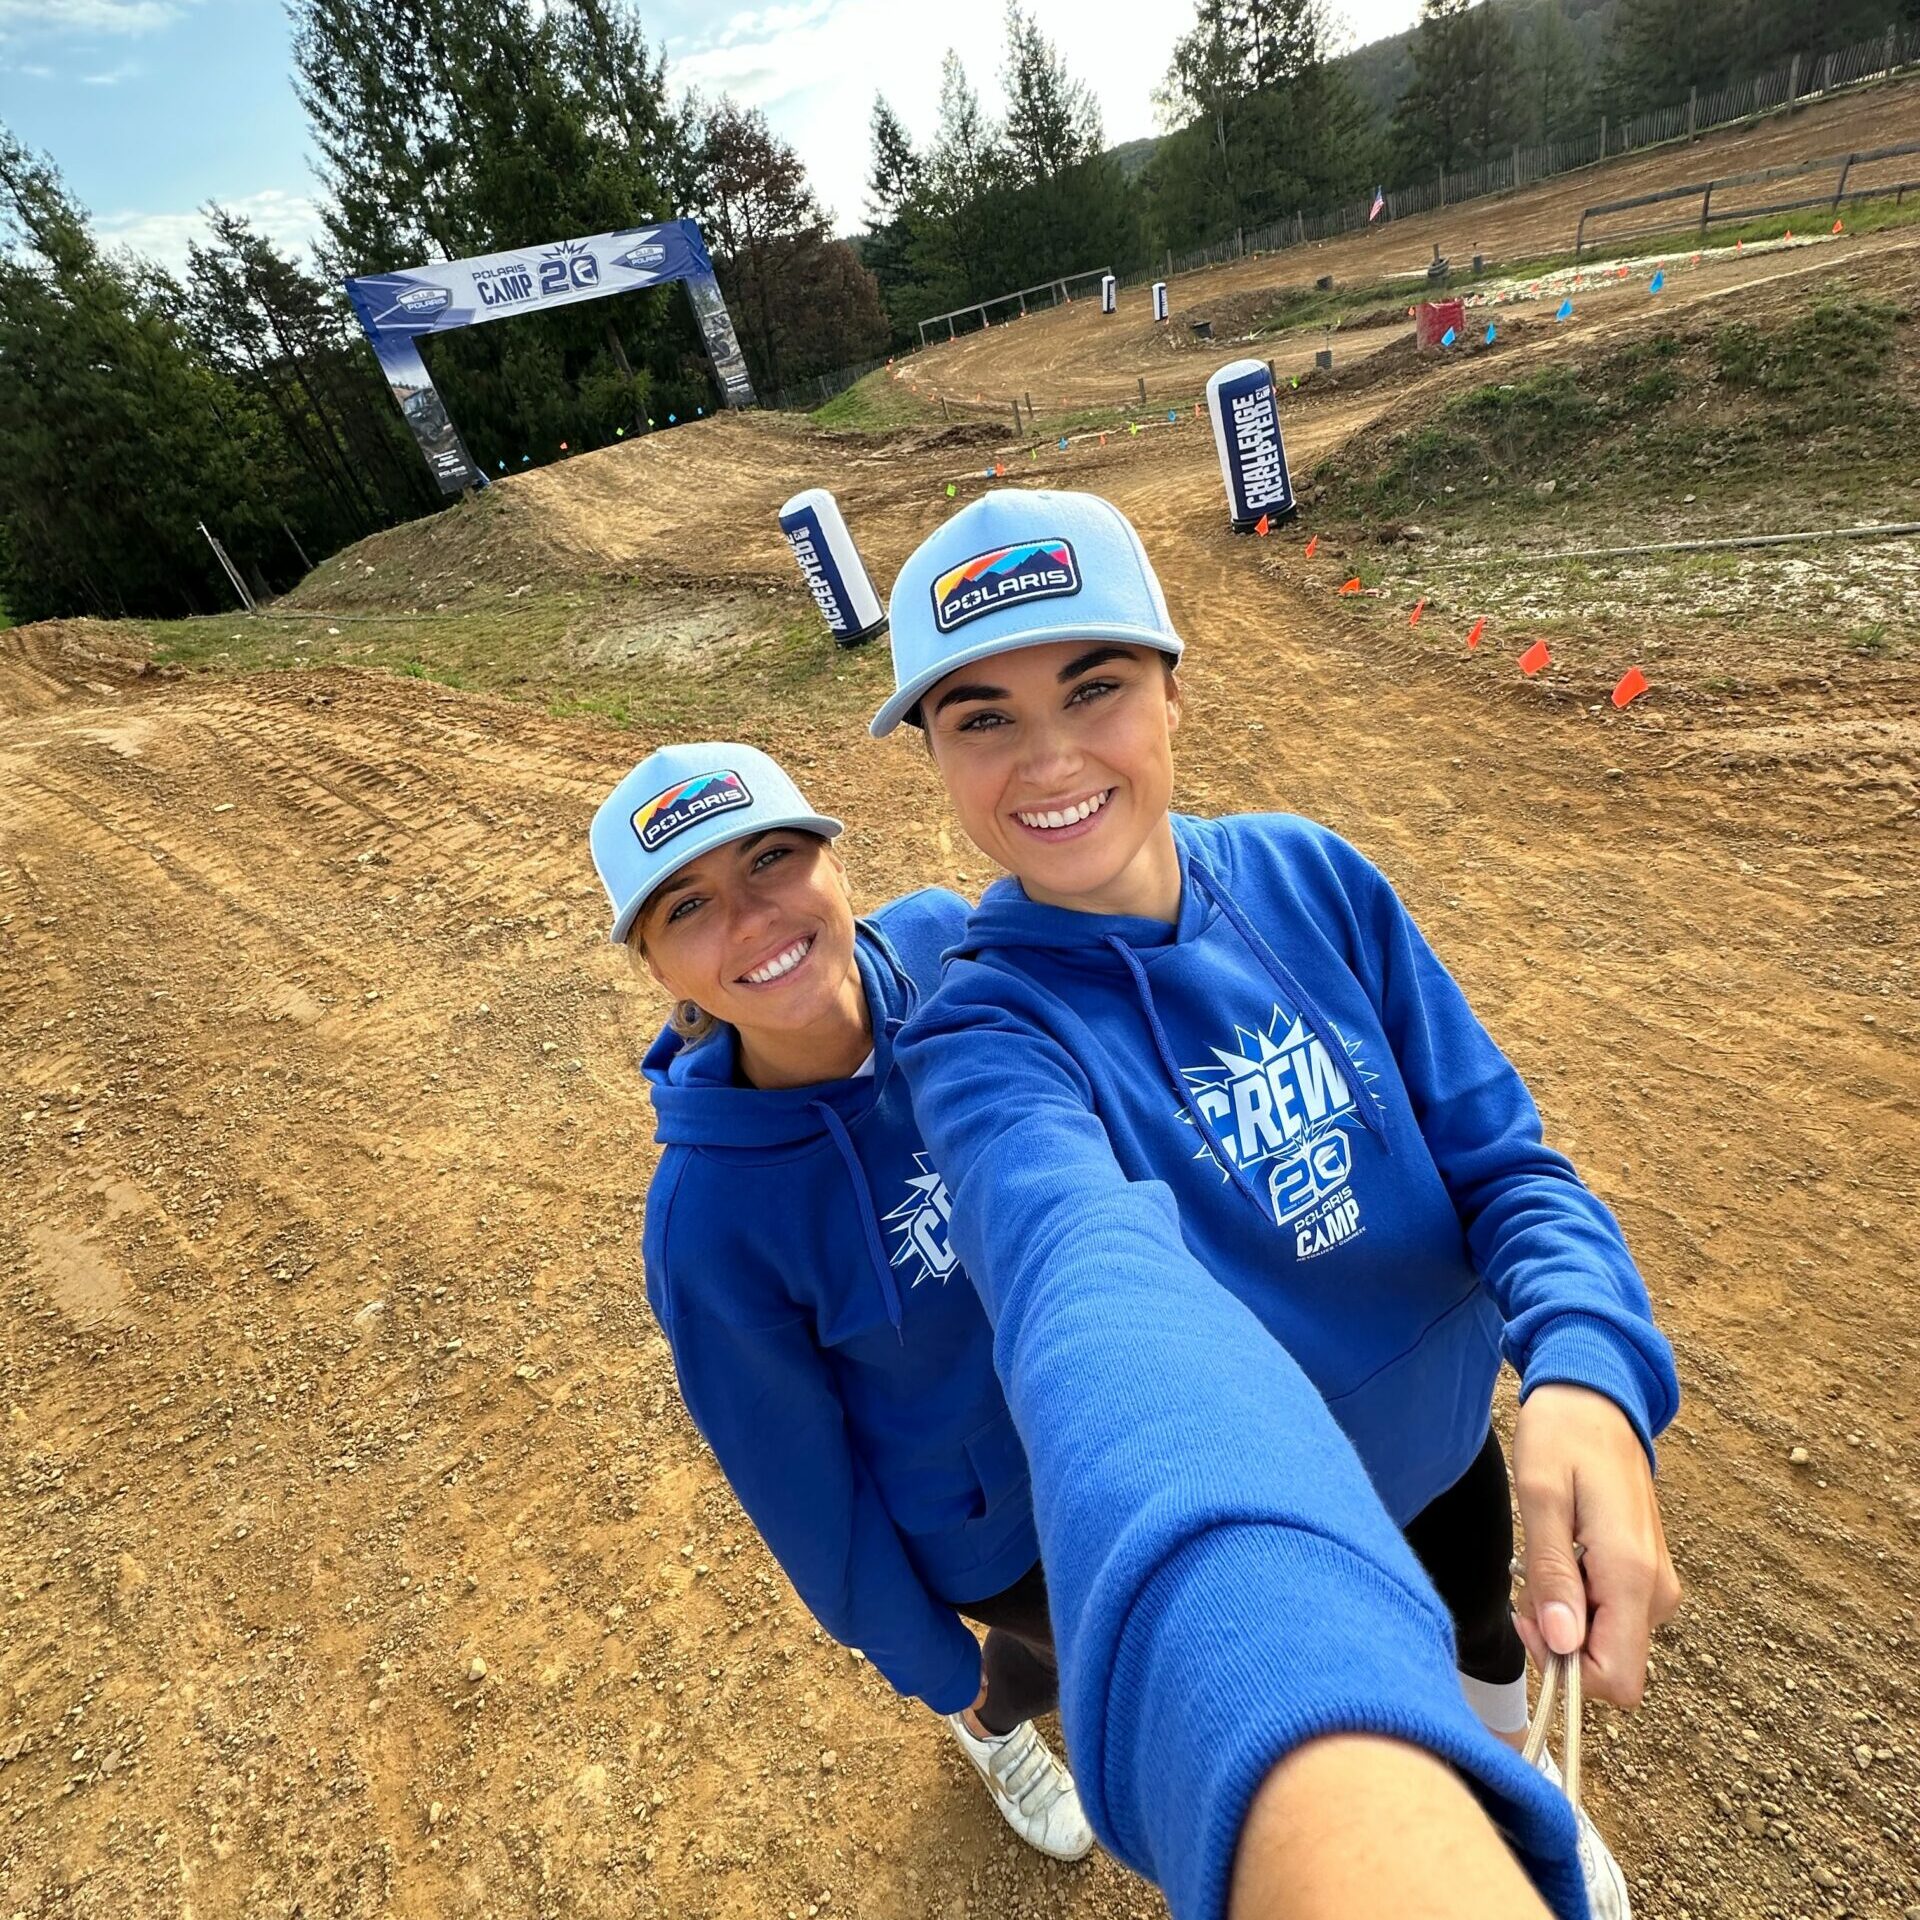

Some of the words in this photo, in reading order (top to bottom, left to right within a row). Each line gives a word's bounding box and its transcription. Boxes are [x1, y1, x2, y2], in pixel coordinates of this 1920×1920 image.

[471, 263, 527, 281] POLARIS
[476, 273, 533, 306] CAMP
[406, 297, 447, 310] POLARIS
[1232, 393, 1267, 510] CHALLENGE
[1252, 400, 1285, 506] ACCEPTED
[791, 540, 848, 631] ACCEPTED
[943, 569, 1068, 620] POLARIS
[646, 789, 742, 841] POLARIS
[1196, 1038, 1351, 1165] CREW
[1293, 1185, 1353, 1233] POLARIS
[1296, 1198, 1360, 1257] CAMP
